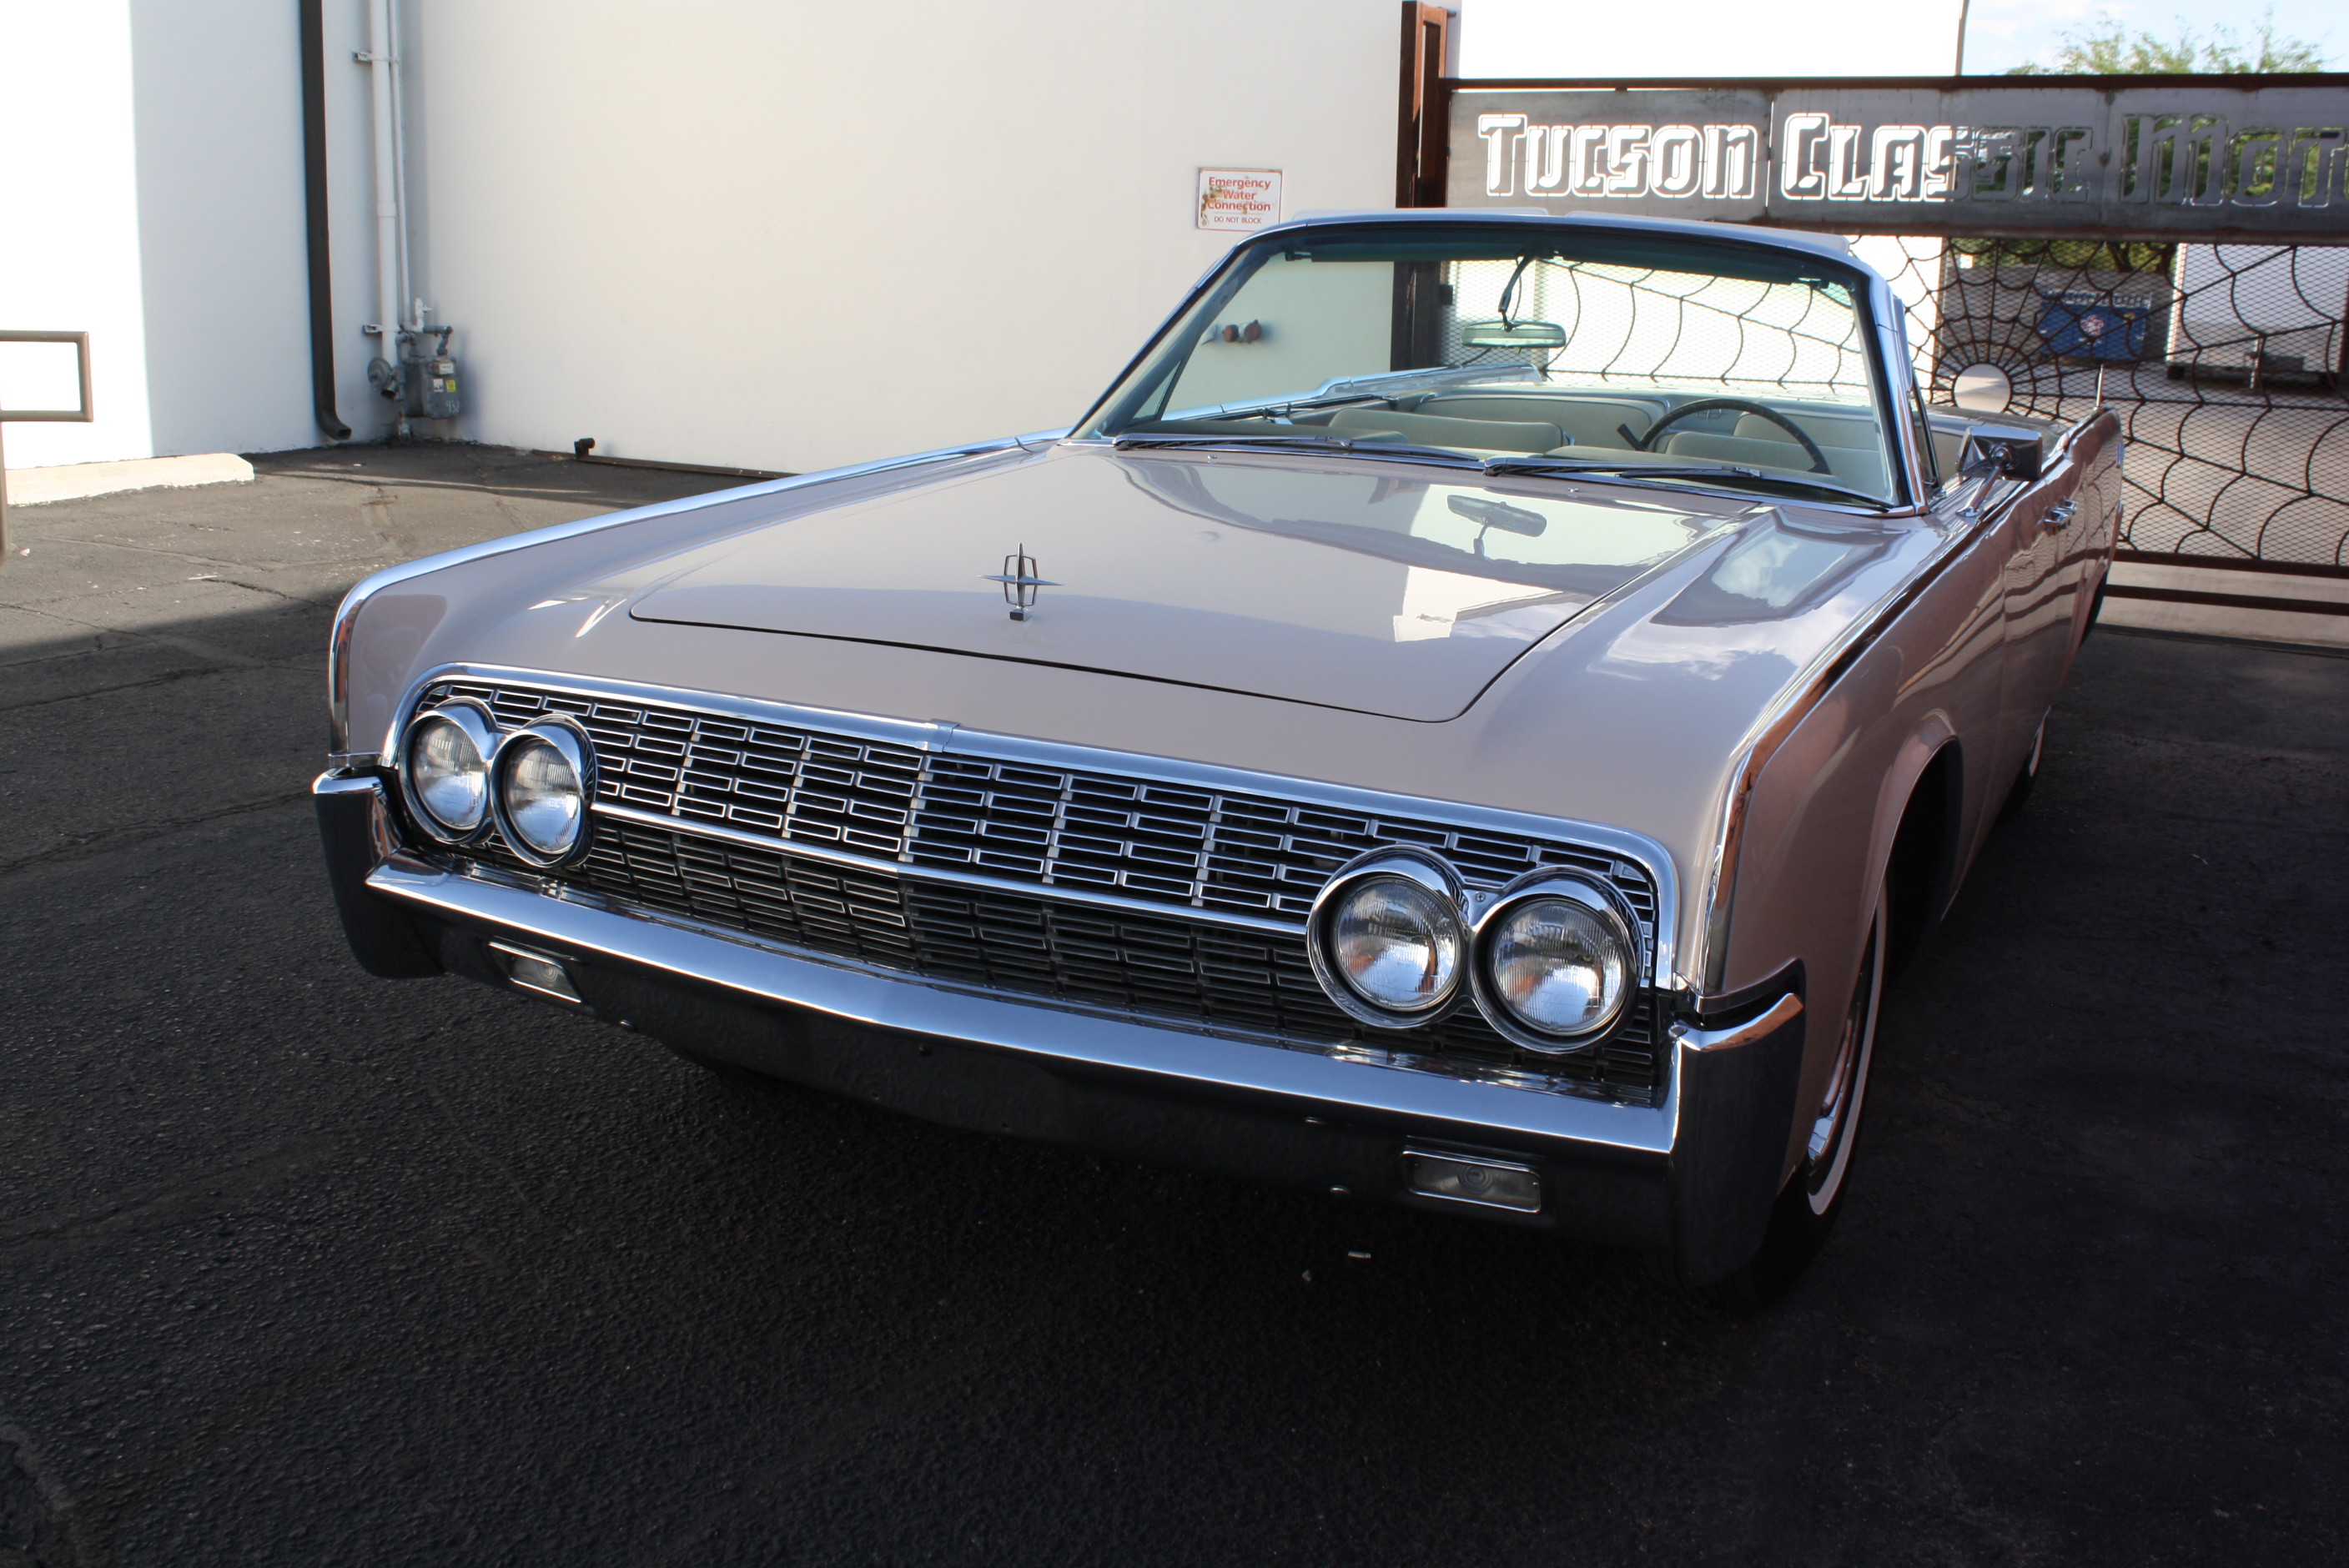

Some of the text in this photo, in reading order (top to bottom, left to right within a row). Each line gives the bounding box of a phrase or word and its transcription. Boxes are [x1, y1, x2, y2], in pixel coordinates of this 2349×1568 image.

[2119, 113, 2349, 208] MOT
[1209, 177, 1270, 189] Emergency
[1223, 190, 1255, 199] Water
[1207, 199, 1270, 211] Connection
[1225, 215, 1239, 224] NOT
[1241, 216, 1262, 224] BLOCK
